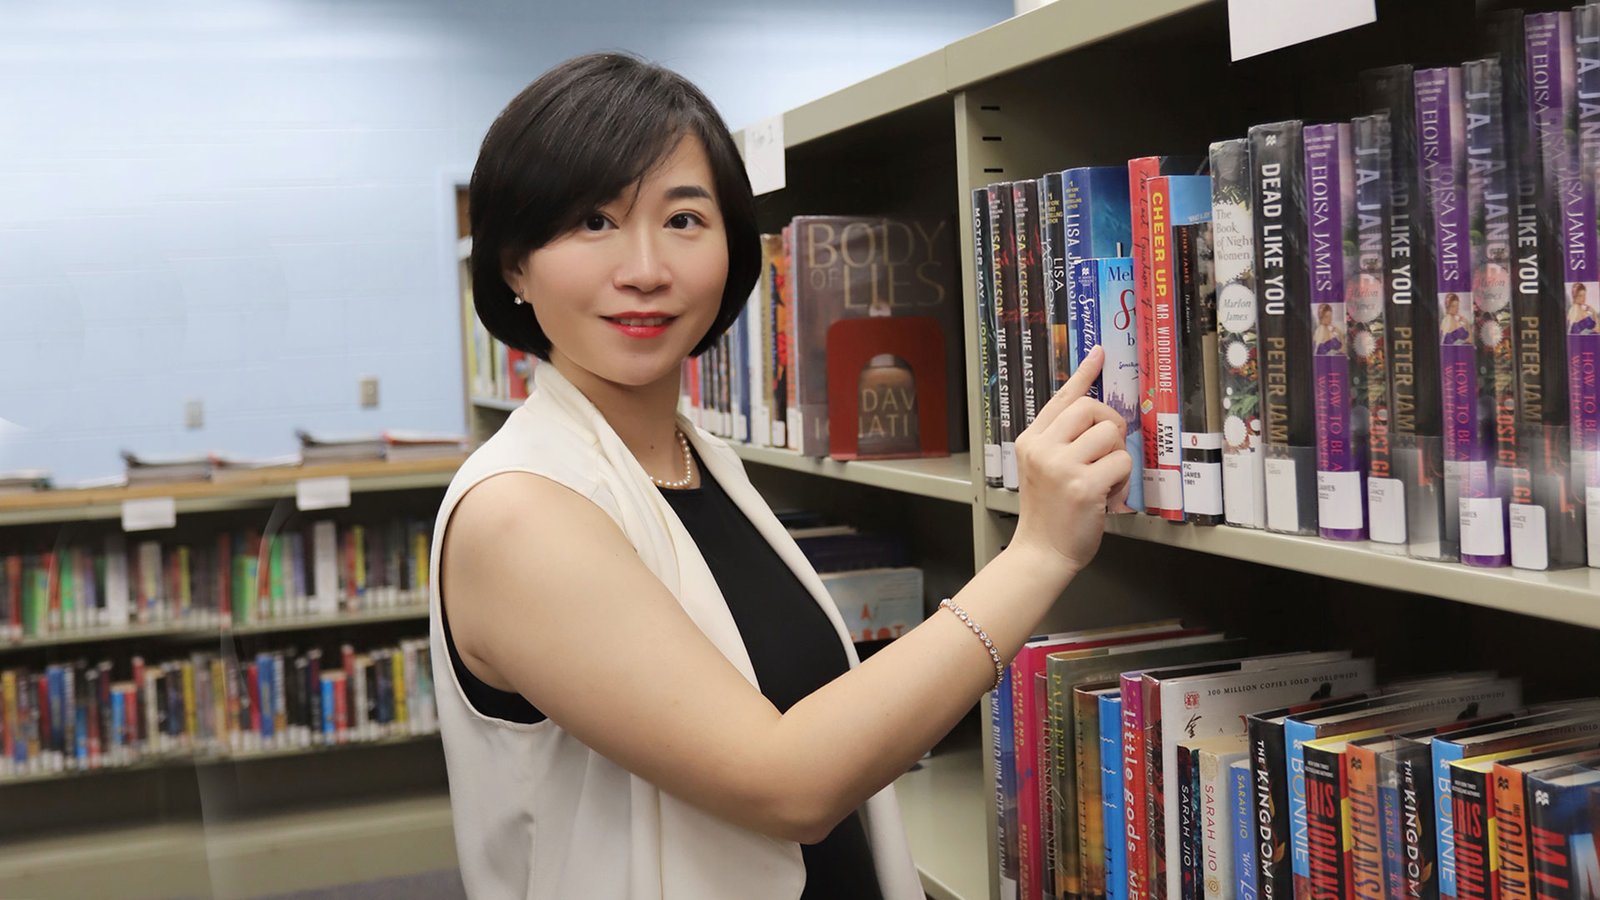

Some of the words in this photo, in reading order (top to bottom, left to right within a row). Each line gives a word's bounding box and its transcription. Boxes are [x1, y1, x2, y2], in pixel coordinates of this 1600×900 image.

[1533, 54, 1550, 114] ELOISA
[1422, 109, 1439, 170] ELOISA
[1261, 163, 1282, 218] DEAD
[1355, 146, 1381, 194] J.A.
[1216, 208, 1232, 220] The
[1311, 165, 1329, 226] ELOISA
[807, 220, 945, 269] BODY
[974, 207, 984, 265] MOTHER
[991, 223, 1001, 252] LISA
[1017, 222, 1026, 252] LISA
[1066, 214, 1080, 246] LISA
[1152, 192, 1166, 262] CHEER
[1216, 222, 1239, 235] Book
[1217, 237, 1224, 250] of
[1225, 235, 1253, 251] Night
[1263, 224, 1284, 268] LIKE
[1391, 214, 1411, 258] LIKE
[1518, 204, 1537, 248] LIKE
[1566, 211, 1587, 271] JAMES
[1217, 249, 1251, 260] Women
[1312, 231, 1333, 292] JAMES
[1439, 222, 1459, 281] JAMES
[810, 269, 839, 290] OF
[843, 261, 945, 309] LIES
[976, 270, 984, 299] MAY
[993, 257, 1004, 317] JACKSON
[1018, 257, 1029, 317] JACKSON
[1053, 258, 1065, 292] LISA
[1155, 269, 1167, 297] UP.
[1392, 264, 1412, 305] YOU
[1519, 253, 1539, 294] YOU
[1156, 303, 1169, 323] MR.
[1223, 298, 1252, 309] Marlon
[1264, 274, 1286, 316] YOU
[1225, 312, 1249, 323] James
[997, 328, 1007, 350] THE
[1022, 329, 1032, 351] THE
[1157, 326, 1173, 393] WIDDICOMBE
[1394, 326, 1414, 386] PETER
[1521, 316, 1540, 376] PETER
[997, 354, 1008, 381] LAST
[1023, 355, 1034, 383] LAST
[1267, 337, 1287, 397] PETER
[1455, 361, 1469, 398] HOW
[1582, 351, 1595, 388] HOW
[861, 387, 915, 413] DAV
[999, 384, 1011, 428] SINNER
[1025, 385, 1036, 428] SINNE
[1328, 372, 1342, 408] HOW
[1584, 393, 1598, 414] TO
[983, 390, 992, 445] JACKSO
[1330, 416, 1344, 437] TO
[1457, 403, 1470, 424] TO
[1157, 421, 1165, 457] JAMES
[1164, 425, 1174, 454] EVAN
[1330, 440, 1344, 456] BE
[1457, 429, 1471, 446] BE
[1183, 471, 1201, 479] JAMES
[1332, 463, 1344, 472] A
[1223, 683, 1258, 695] MILLION
[1259, 680, 1288, 690] COPIES
[1290, 677, 1310, 686] SOLD
[1312, 671, 1359, 683] WORLDWIDE
[1052, 674, 1065, 777] PAULETTE
[1123, 709, 1138, 780] little
[1256, 740, 1266, 765] THE
[1404, 760, 1413, 783] THE
[1181, 784, 1191, 838] SARAH
[1204, 784, 1216, 840] SARAH
[1236, 774, 1248, 816] SARAH
[1291, 757, 1310, 863] BONNIE
[1305, 777, 1335, 819] IRIS
[1383, 794, 1395, 835] SARAH
[1124, 787, 1141, 852] gods
[1239, 819, 1249, 839] JIO
[1256, 769, 1274, 880] KINGDOM
[1438, 777, 1456, 882] BONNIE
[1452, 797, 1482, 839] IRIS
[1182, 841, 1192, 867] JIO
[1207, 848, 1218, 872] JIO
[1307, 812, 1339, 900] JOHANS
[1404, 788, 1421, 898] KINGDOM
[1496, 798, 1526, 896] JOHAN
[1128, 870, 1139, 900] ME
